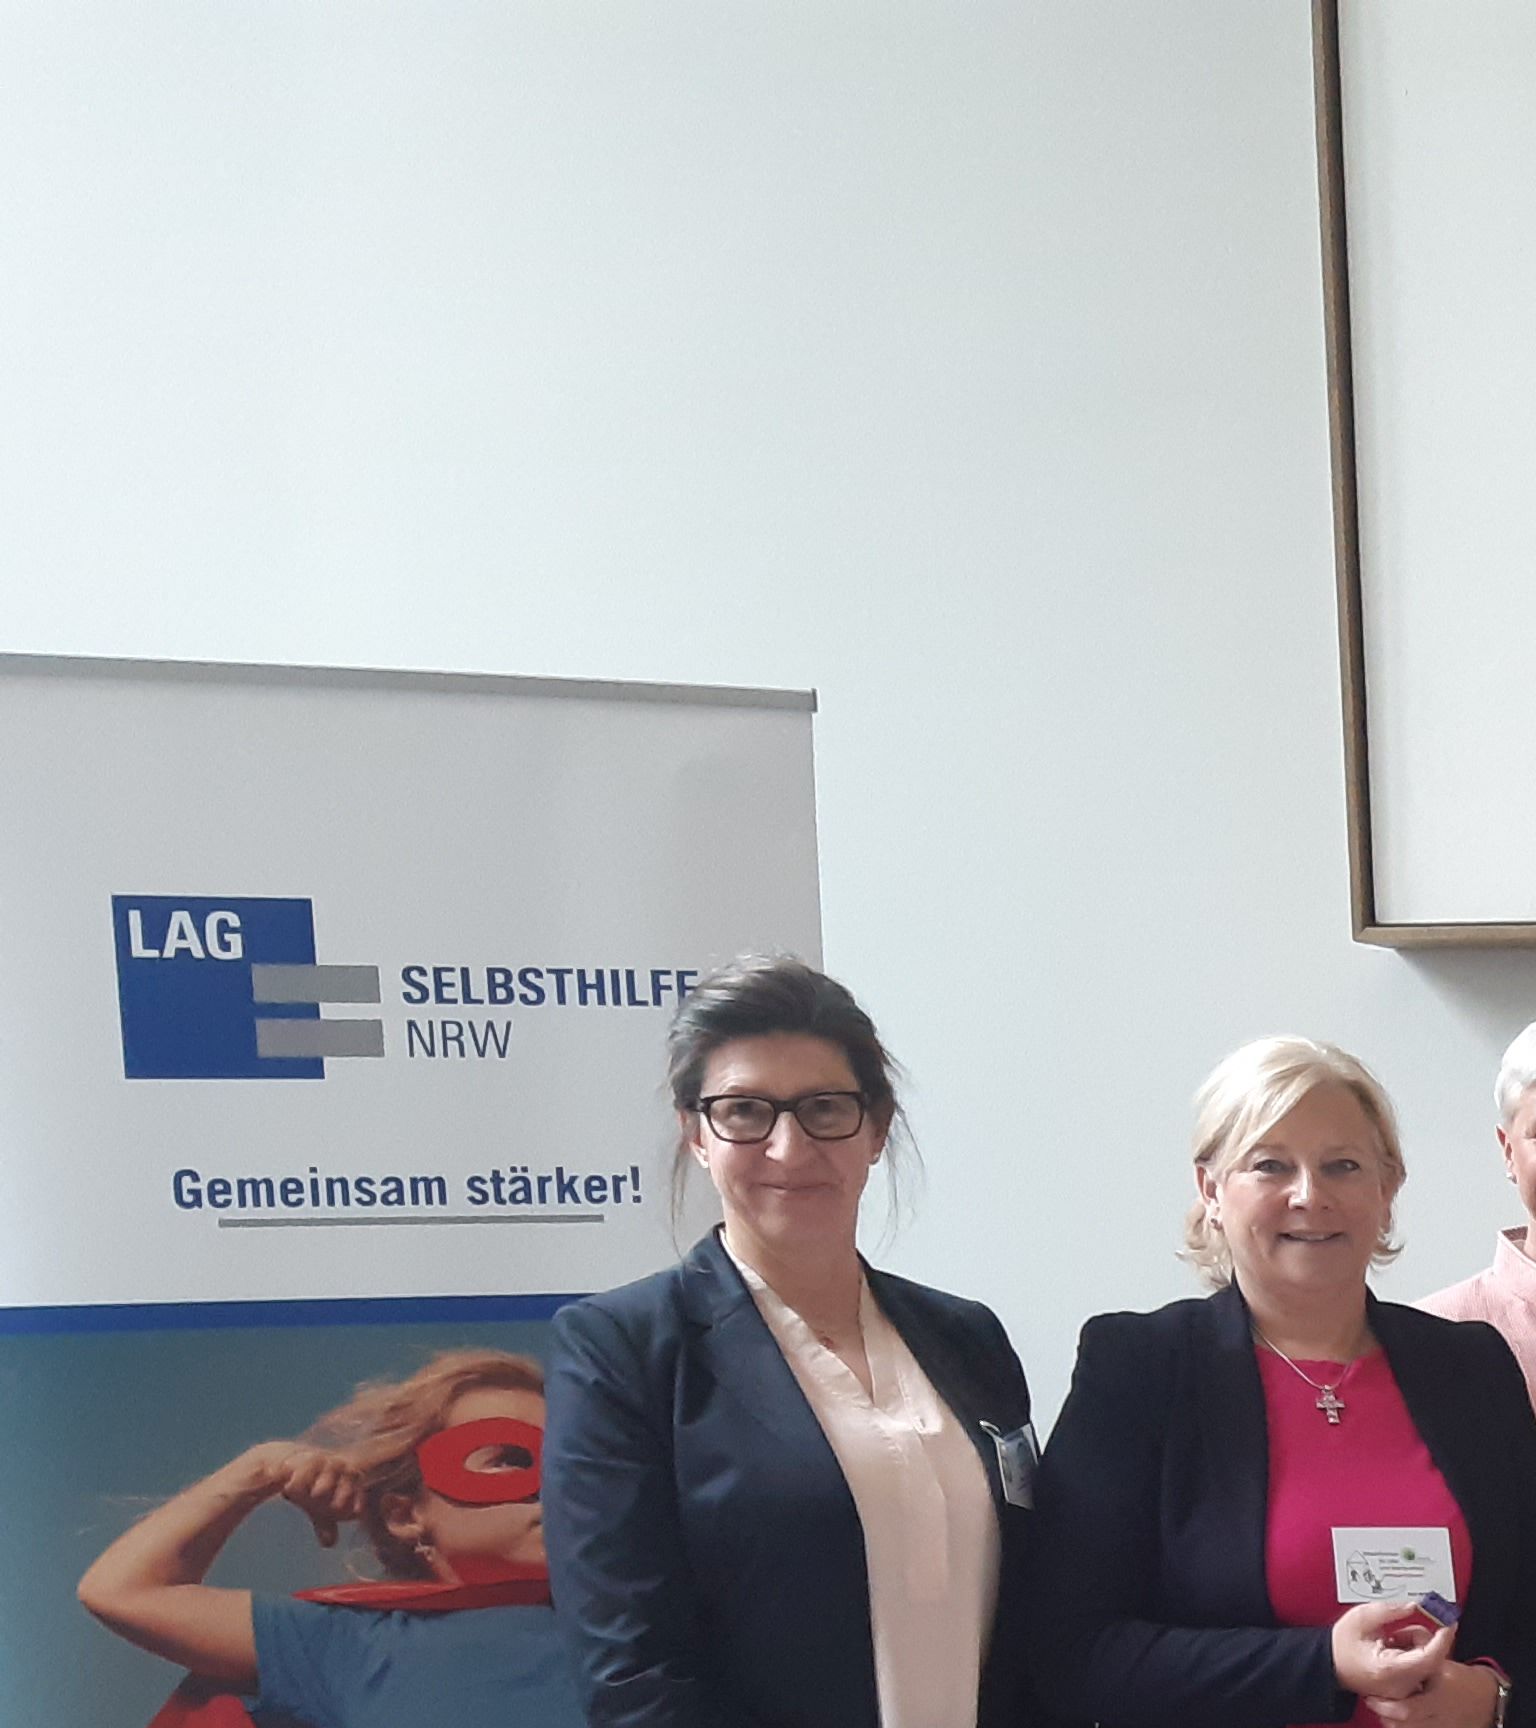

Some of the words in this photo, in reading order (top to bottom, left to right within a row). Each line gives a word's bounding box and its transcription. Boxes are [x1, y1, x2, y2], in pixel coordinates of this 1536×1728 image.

[127, 909, 244, 962] LAG
[406, 1020, 513, 1059] NRW
[173, 1167, 448, 1209] Gemeinsam
[466, 1164, 643, 1205] stärker!
